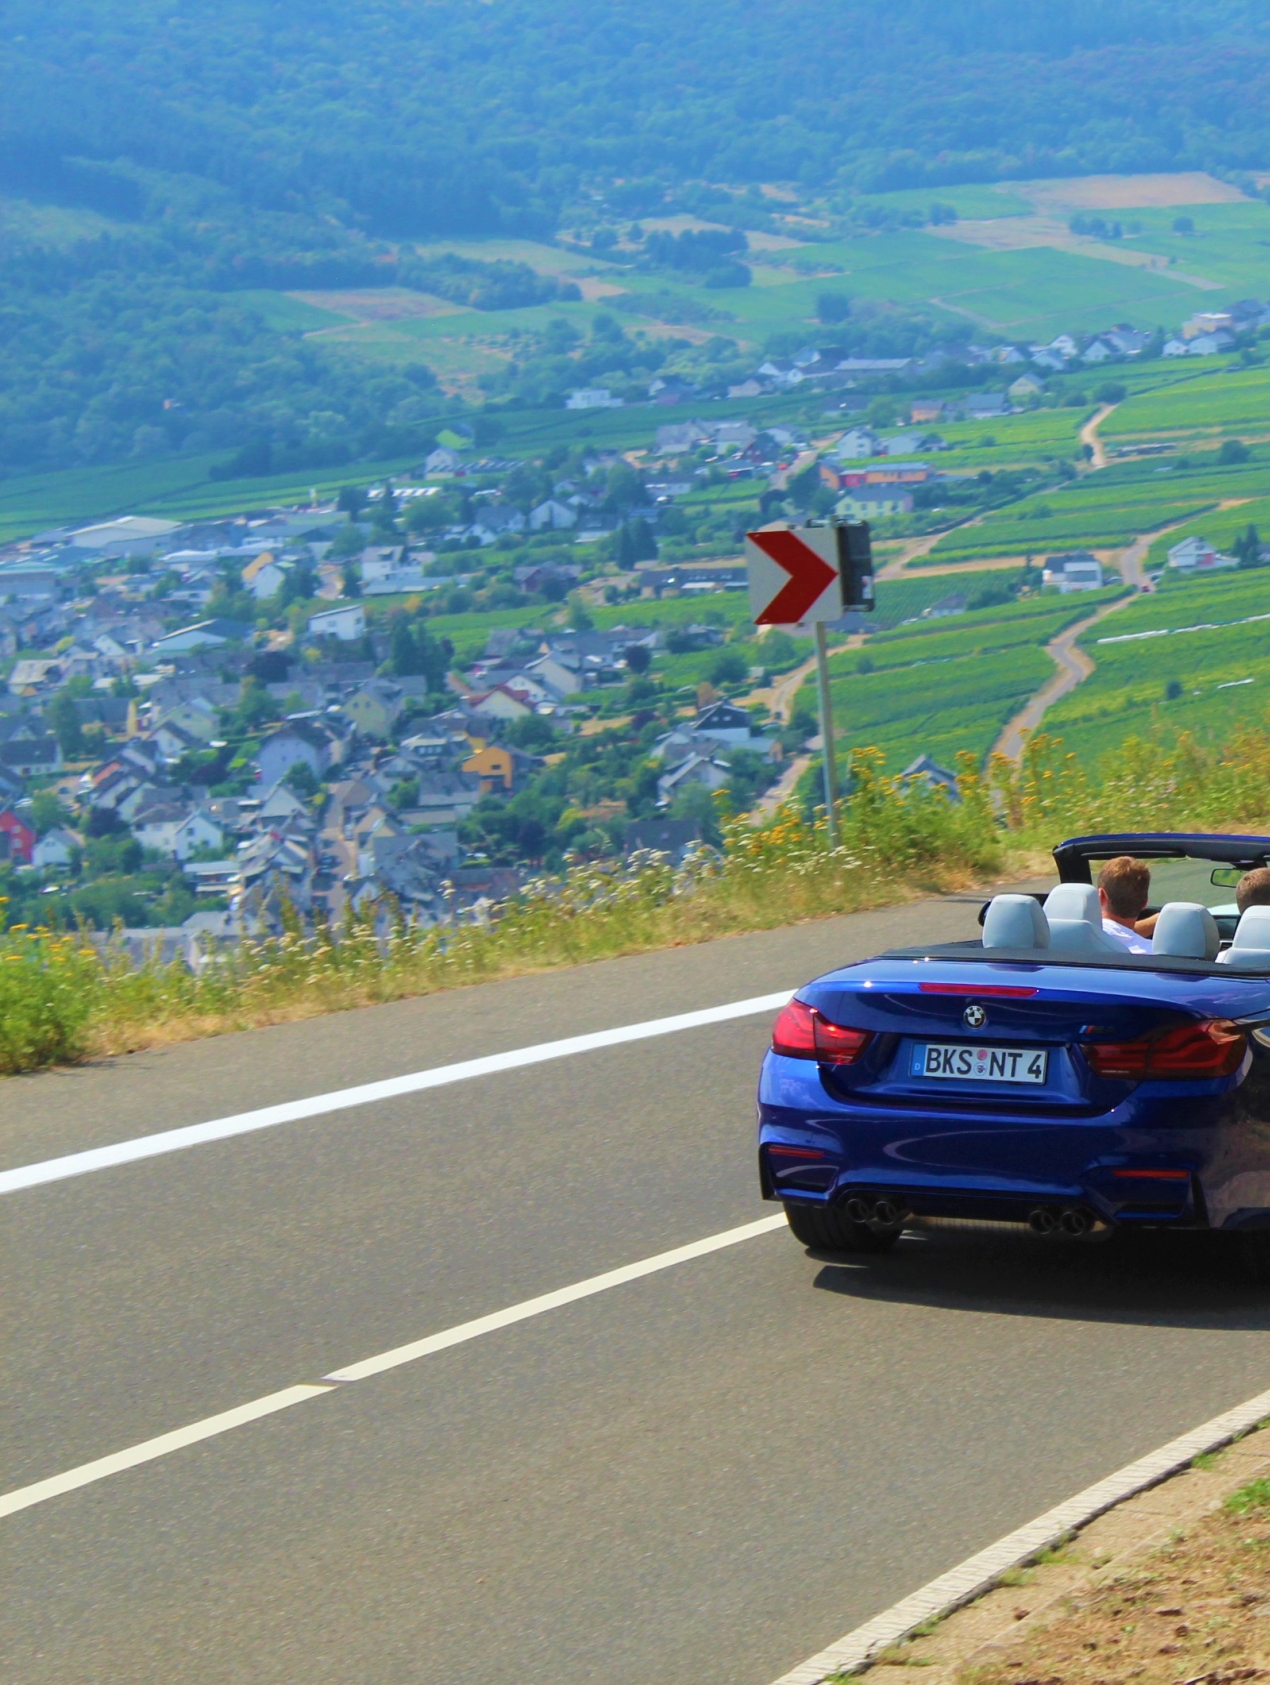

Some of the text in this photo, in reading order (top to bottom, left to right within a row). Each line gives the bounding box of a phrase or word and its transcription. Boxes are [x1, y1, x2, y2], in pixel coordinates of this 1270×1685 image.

[925, 1047, 1042, 1079] BKS NT 4
